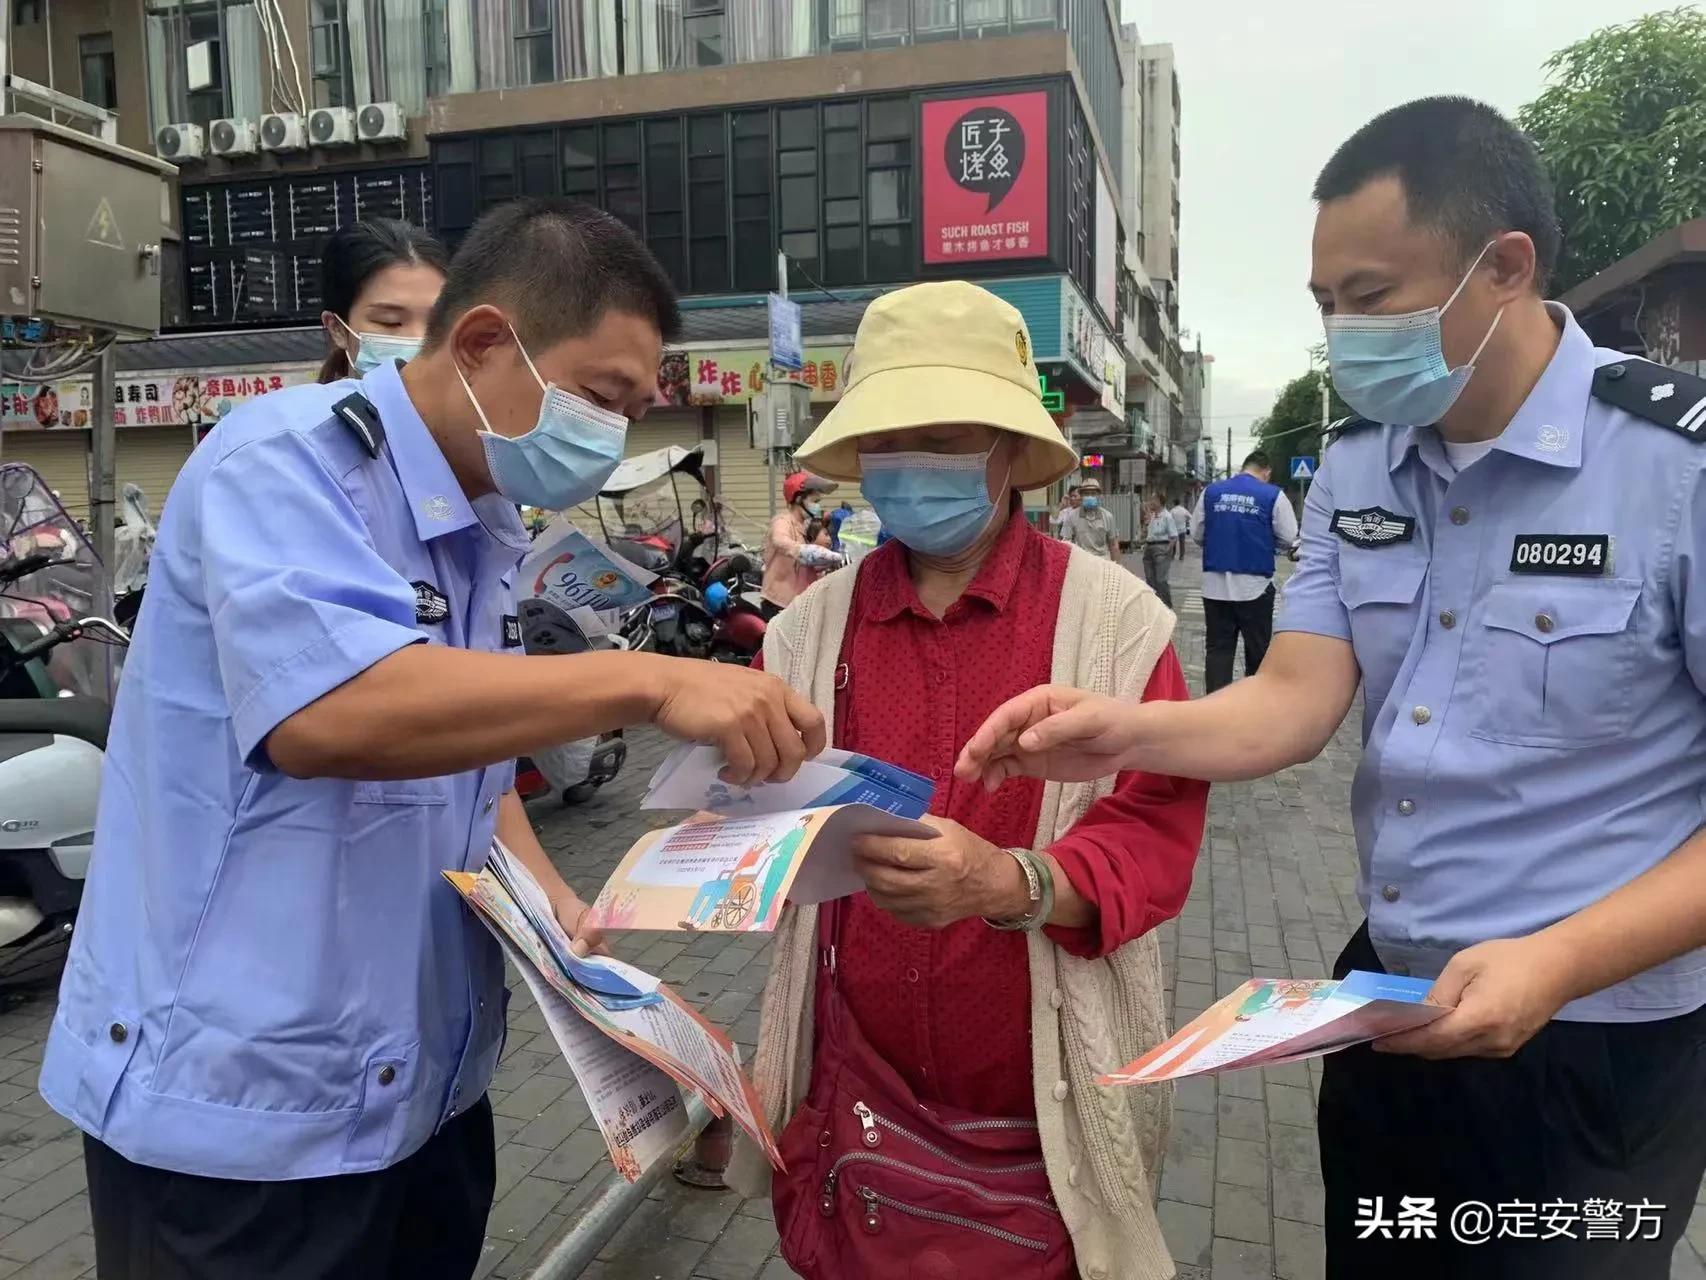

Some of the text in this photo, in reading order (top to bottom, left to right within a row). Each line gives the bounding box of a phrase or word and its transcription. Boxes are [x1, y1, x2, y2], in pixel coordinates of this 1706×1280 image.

[941, 221, 1029, 239] SUCH ROAST FISH
[207, 376, 283, 398] 章鱼小丸子
[1516, 543, 1602, 566] 080294
